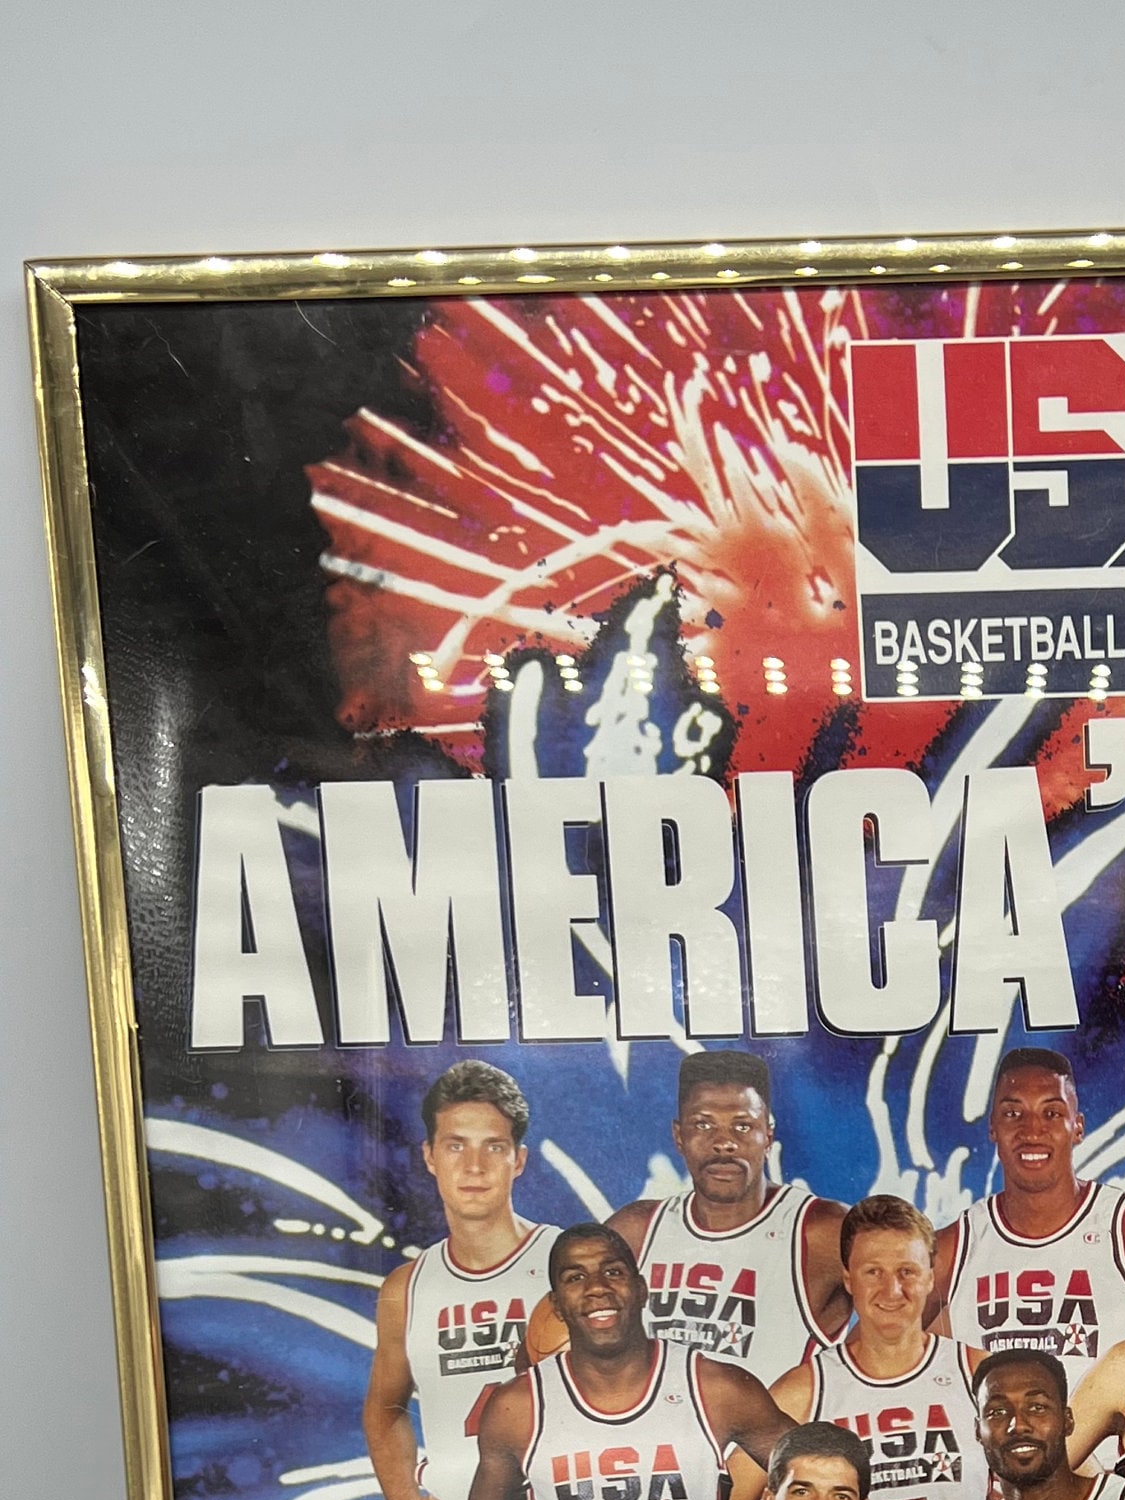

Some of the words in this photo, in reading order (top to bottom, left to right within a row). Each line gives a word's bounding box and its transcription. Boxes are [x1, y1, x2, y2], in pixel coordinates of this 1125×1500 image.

[438, 1297, 527, 1351] USA
[649, 1262, 757, 1327] USA
[976, 1269, 1099, 1330] USA
